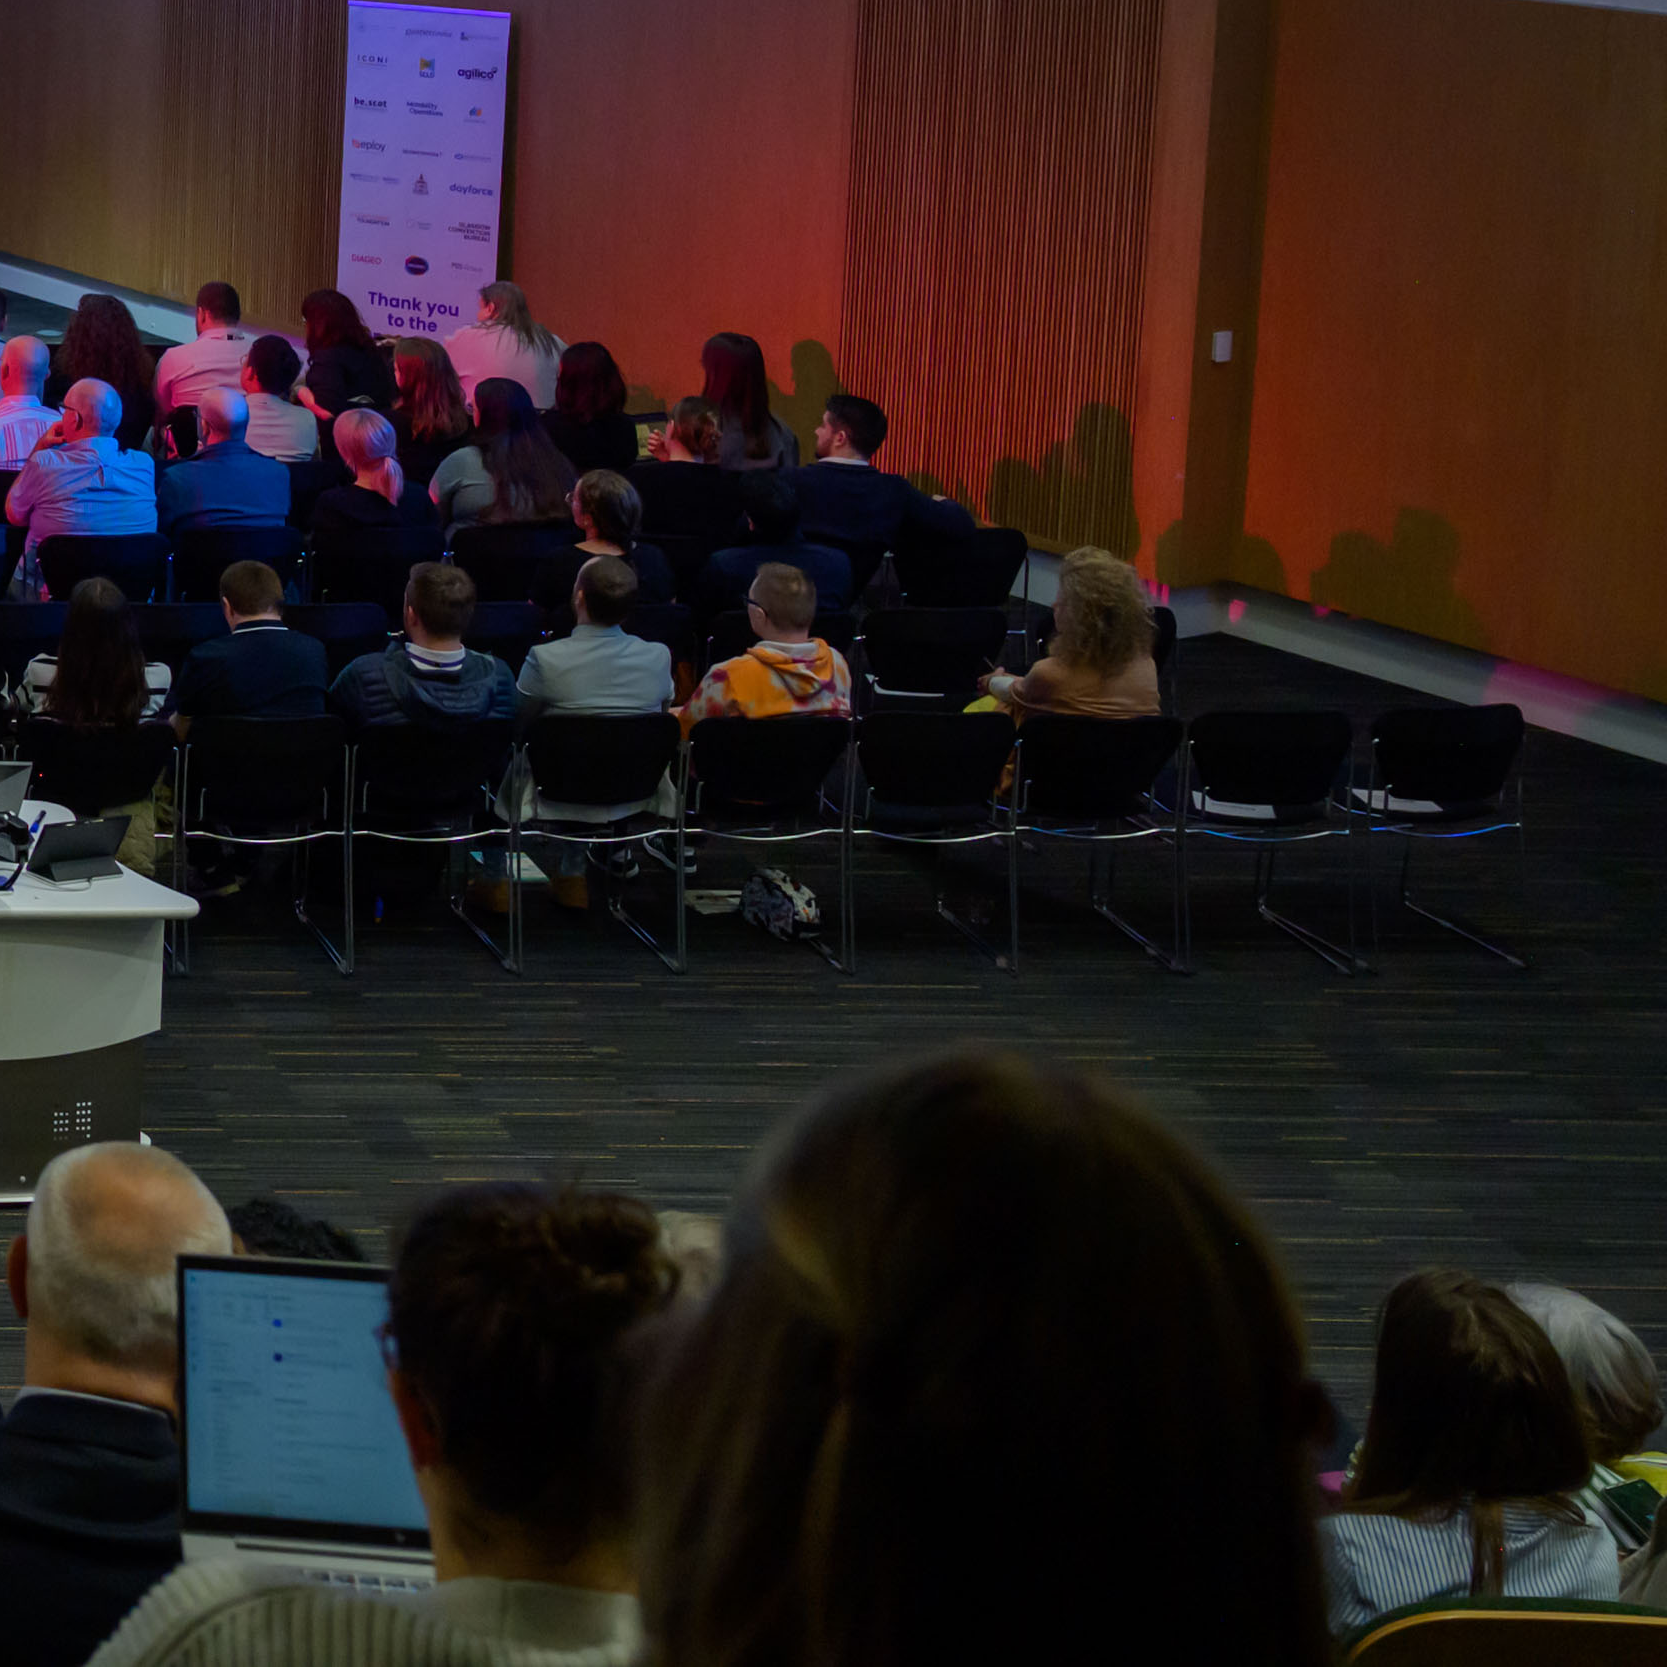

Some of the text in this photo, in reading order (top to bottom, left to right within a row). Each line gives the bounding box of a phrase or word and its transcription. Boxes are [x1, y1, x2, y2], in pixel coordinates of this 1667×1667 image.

[367, 291, 460, 318] Thank you
[387, 313, 438, 332] to the
